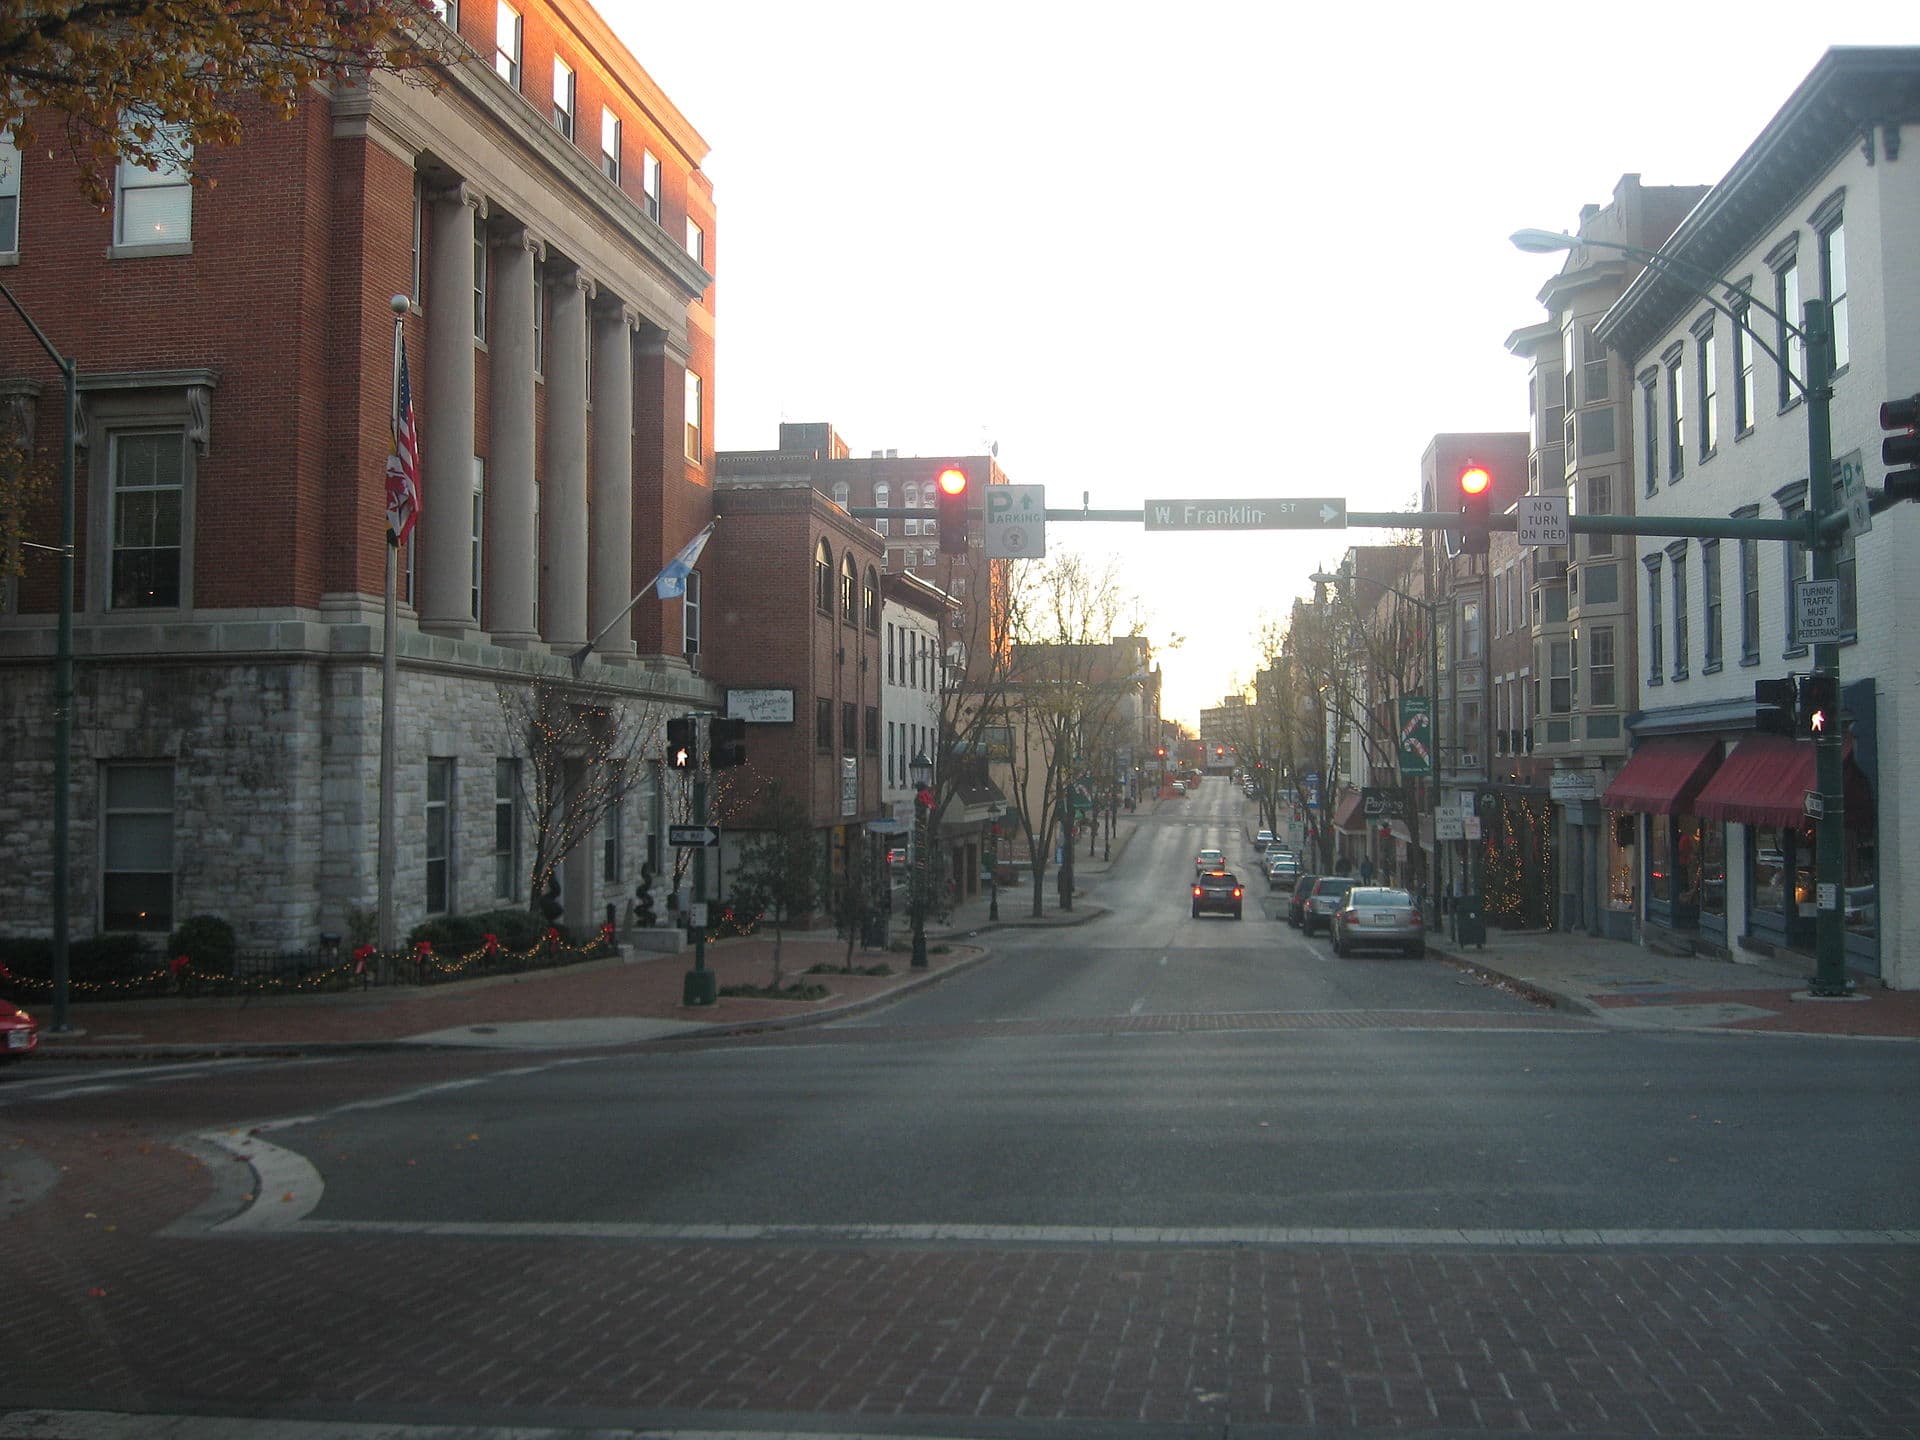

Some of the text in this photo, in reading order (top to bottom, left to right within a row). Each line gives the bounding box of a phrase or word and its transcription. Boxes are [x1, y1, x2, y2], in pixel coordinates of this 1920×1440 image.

[1533, 501, 1552, 511] NO
[1155, 503, 1296, 524] W. Franklin ST
[1528, 515, 1558, 525] TURN
[1521, 529, 1566, 539] ON RED
[1802, 585, 1834, 597] TURNING
[1803, 595, 1833, 606] TRAFFIC
[1807, 606, 1828, 616] MUST
[1801, 617, 1836, 628] YIELD TO
[1800, 627, 1839, 638] PEDESTRIANS
[1442, 808, 1455, 817] NO
